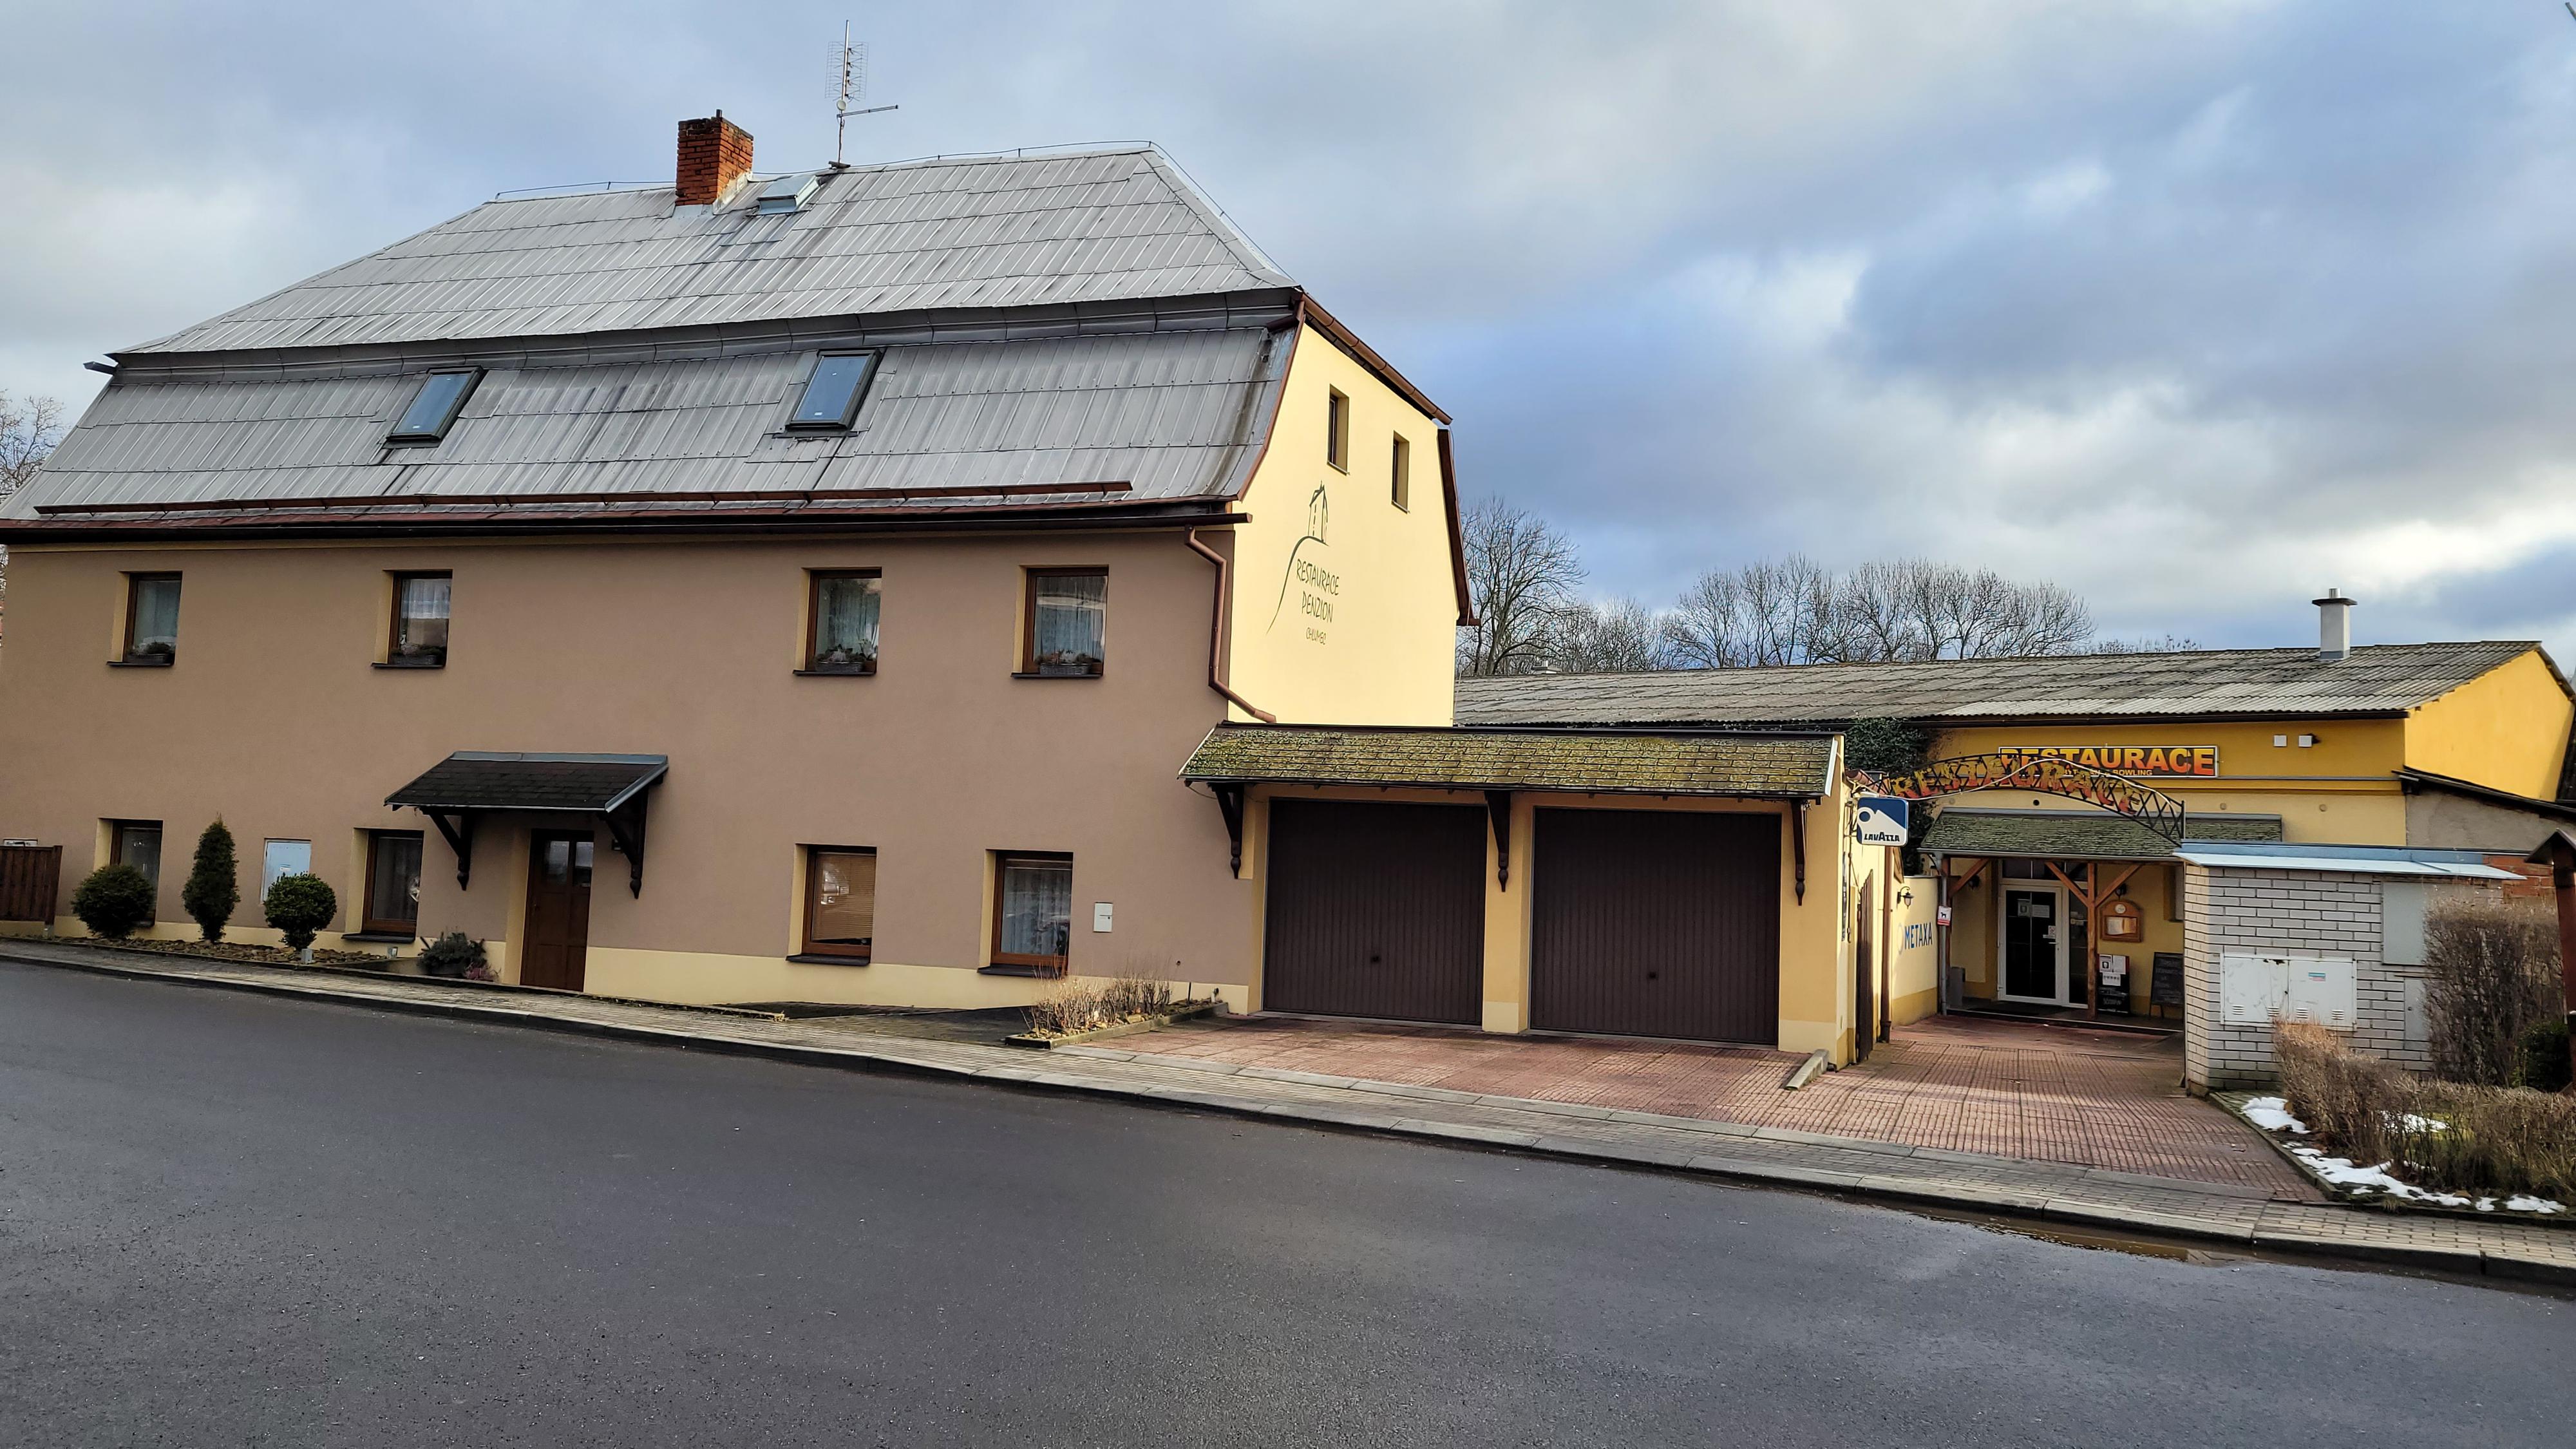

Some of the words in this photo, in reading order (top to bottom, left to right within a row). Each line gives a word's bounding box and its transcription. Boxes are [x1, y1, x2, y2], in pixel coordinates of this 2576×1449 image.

[1296, 558, 1339, 596] RESTAURACE
[1302, 591, 1333, 623] PENZION
[1864, 831, 1900, 842] LAVAZZA
[1905, 922, 1933, 949] METAXA
